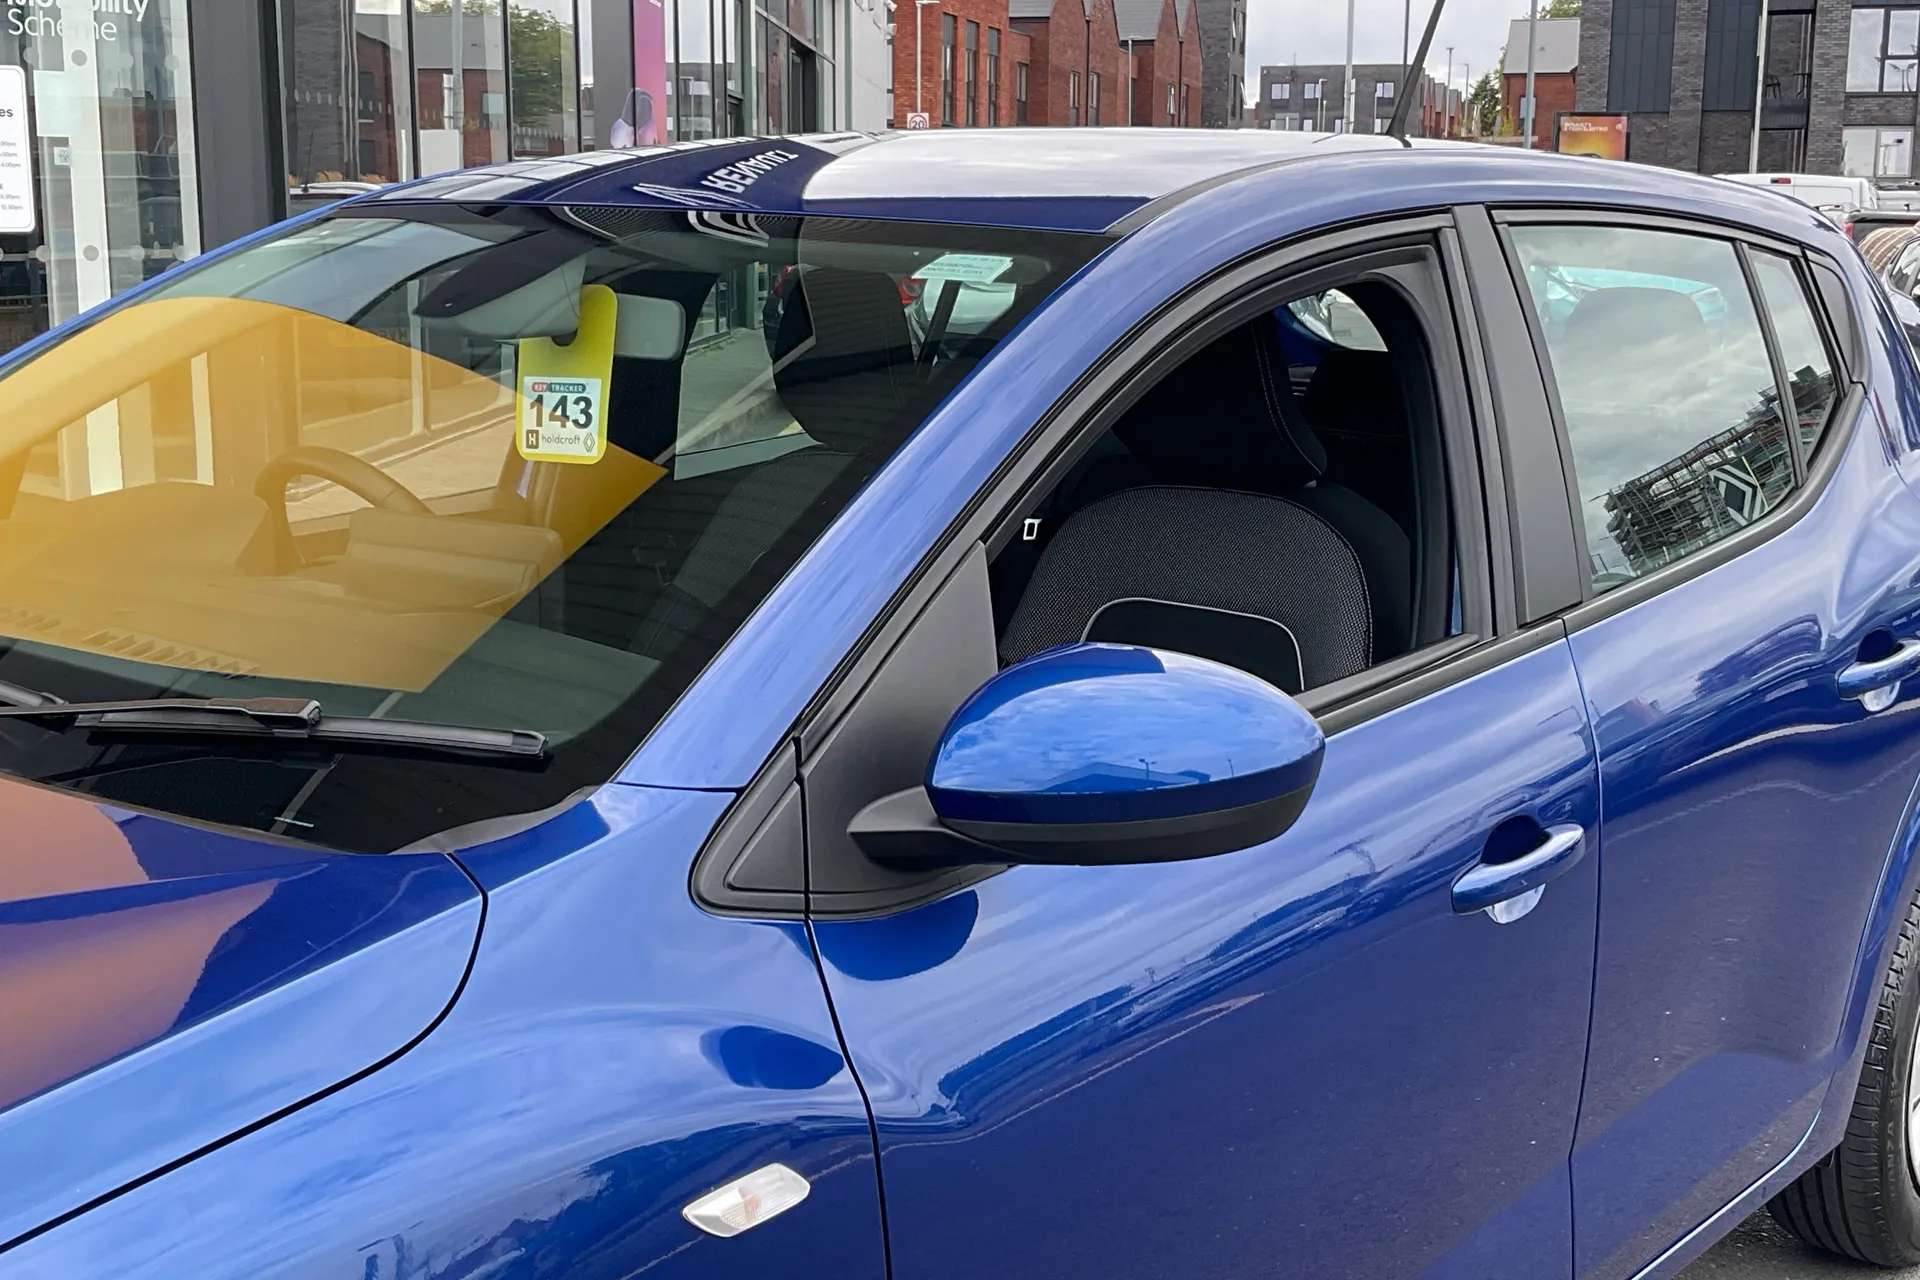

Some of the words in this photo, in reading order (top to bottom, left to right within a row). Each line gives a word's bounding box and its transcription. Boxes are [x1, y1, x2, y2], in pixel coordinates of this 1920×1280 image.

[7, 8, 118, 41] Schee
[551, 384, 583, 393] TRACKER
[529, 394, 593, 429] 143
[541, 433, 581, 445] holdcroft
